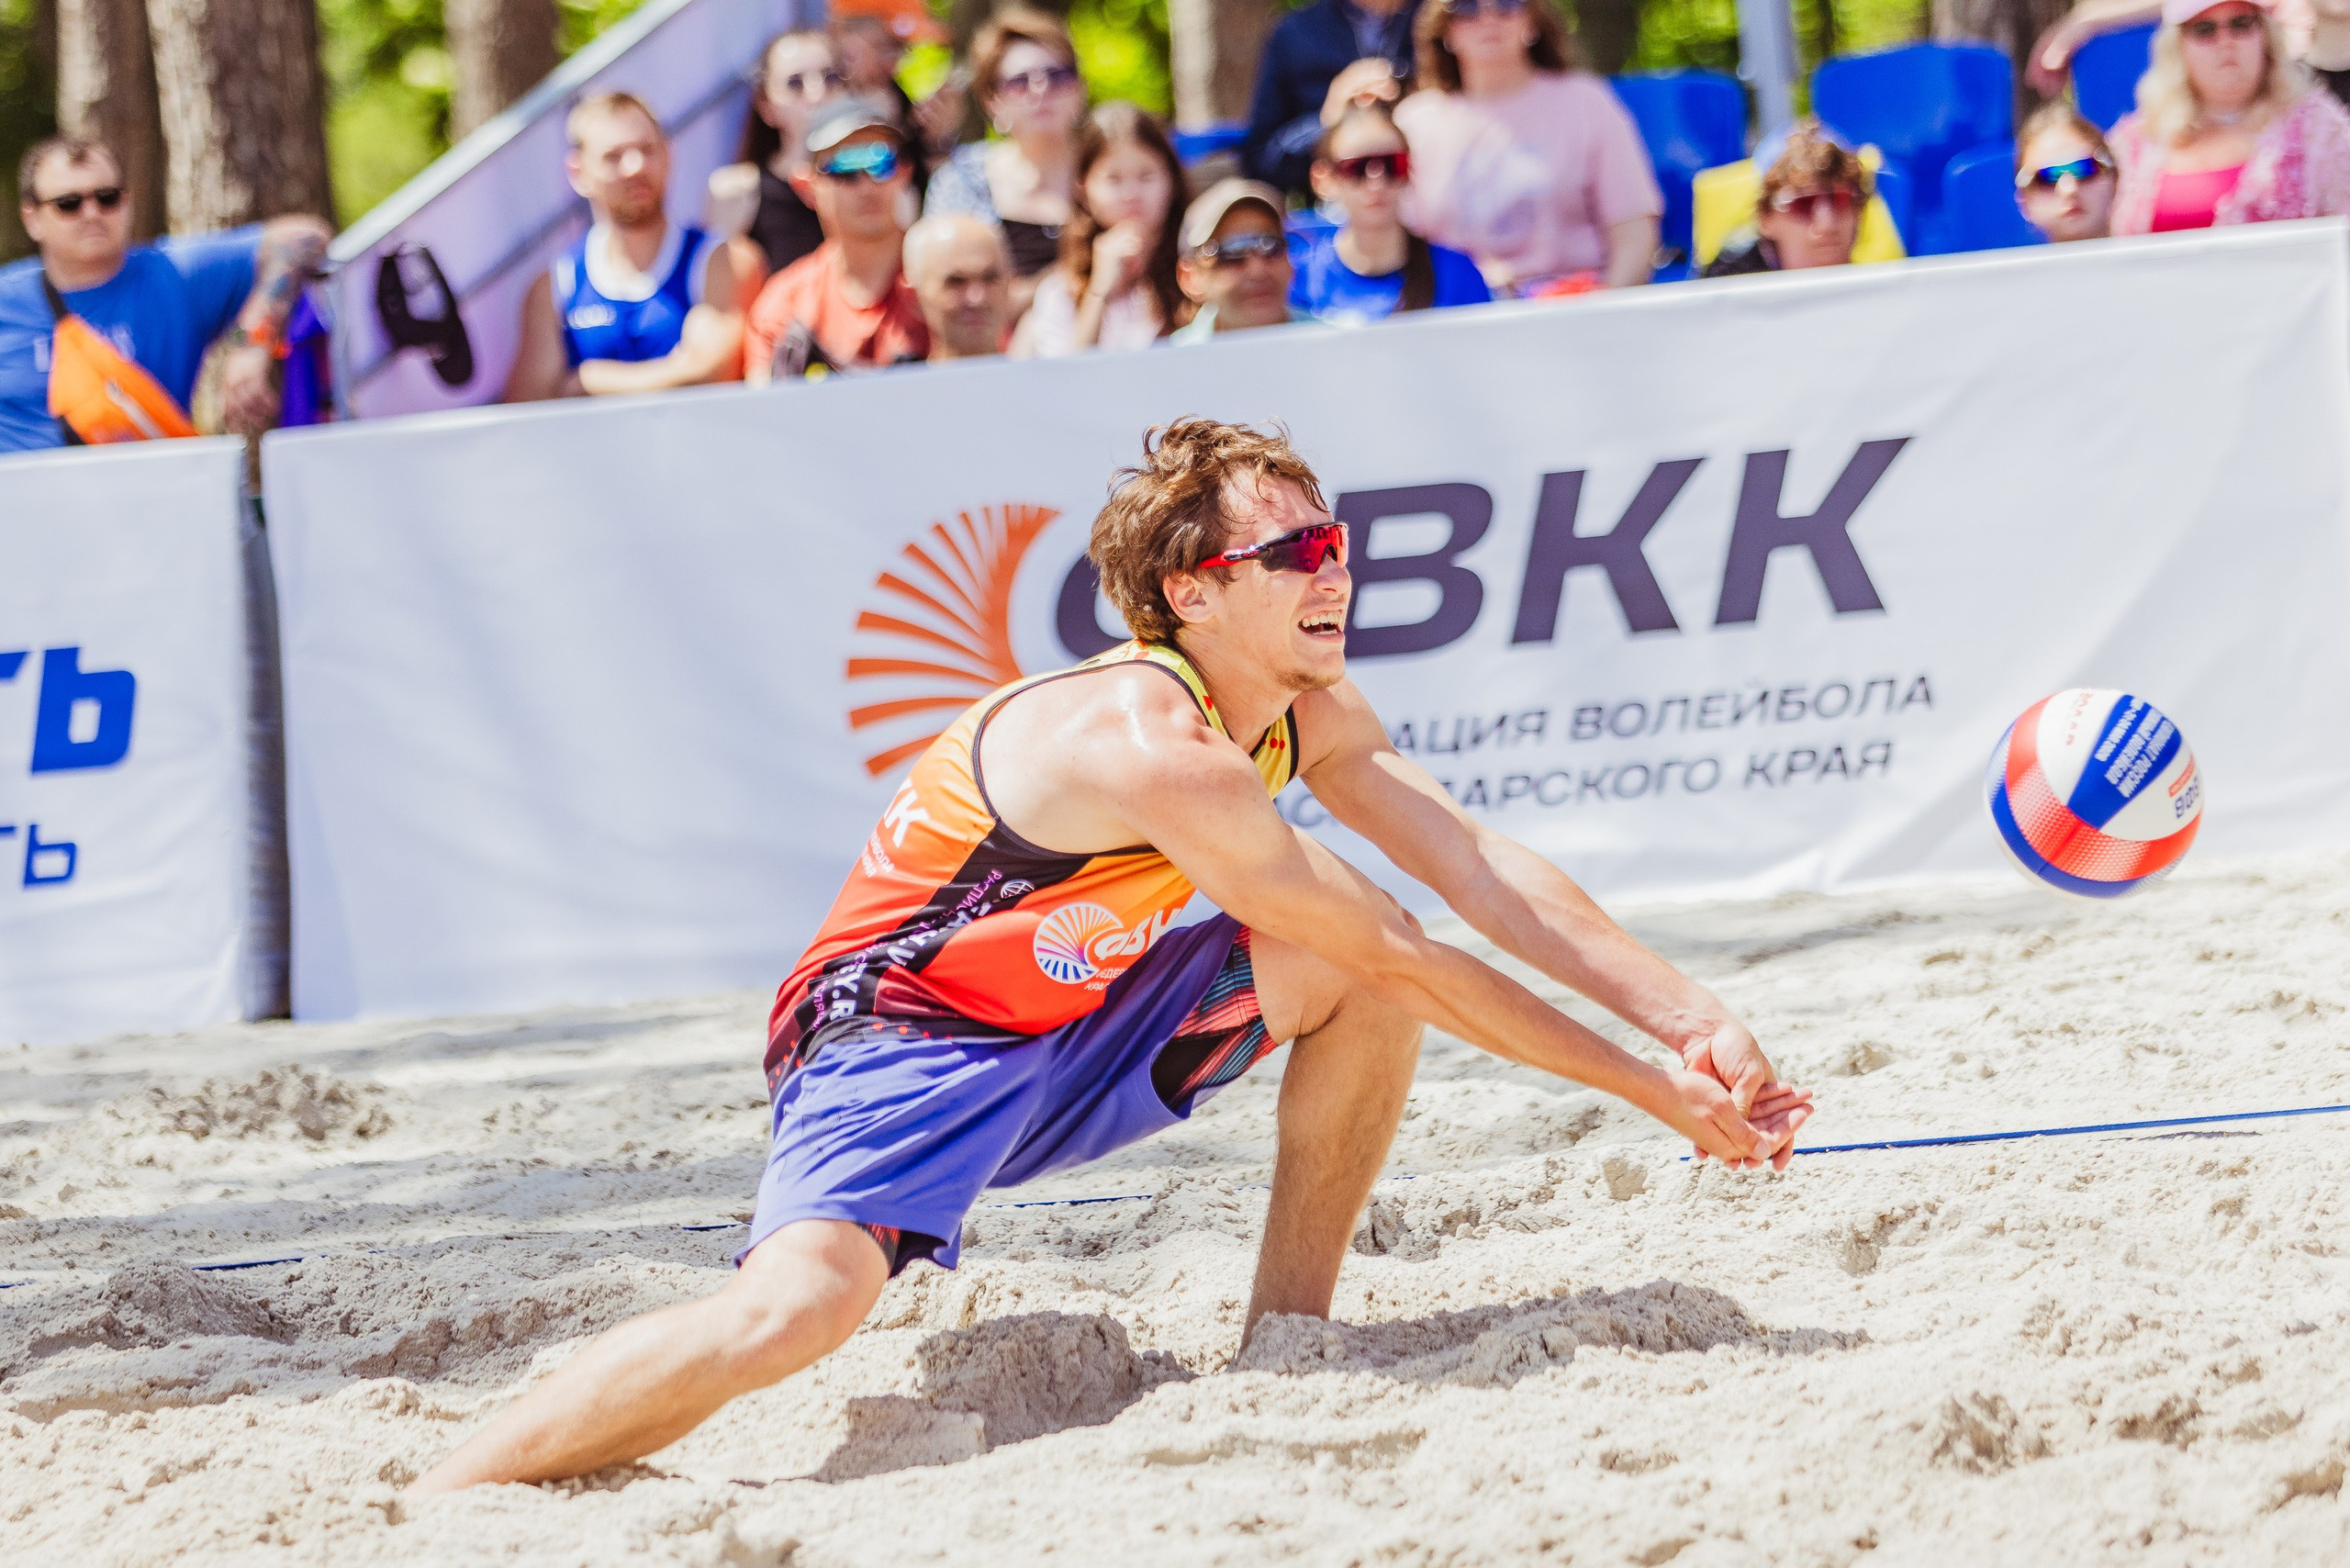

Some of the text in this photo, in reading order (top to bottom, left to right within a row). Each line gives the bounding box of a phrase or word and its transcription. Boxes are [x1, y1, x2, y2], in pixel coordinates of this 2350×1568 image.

[1393, 675, 1935, 756] АЦИЯ ВОЛЕЙБОЛА
[1744, 740, 1895, 790] КРАЯ
